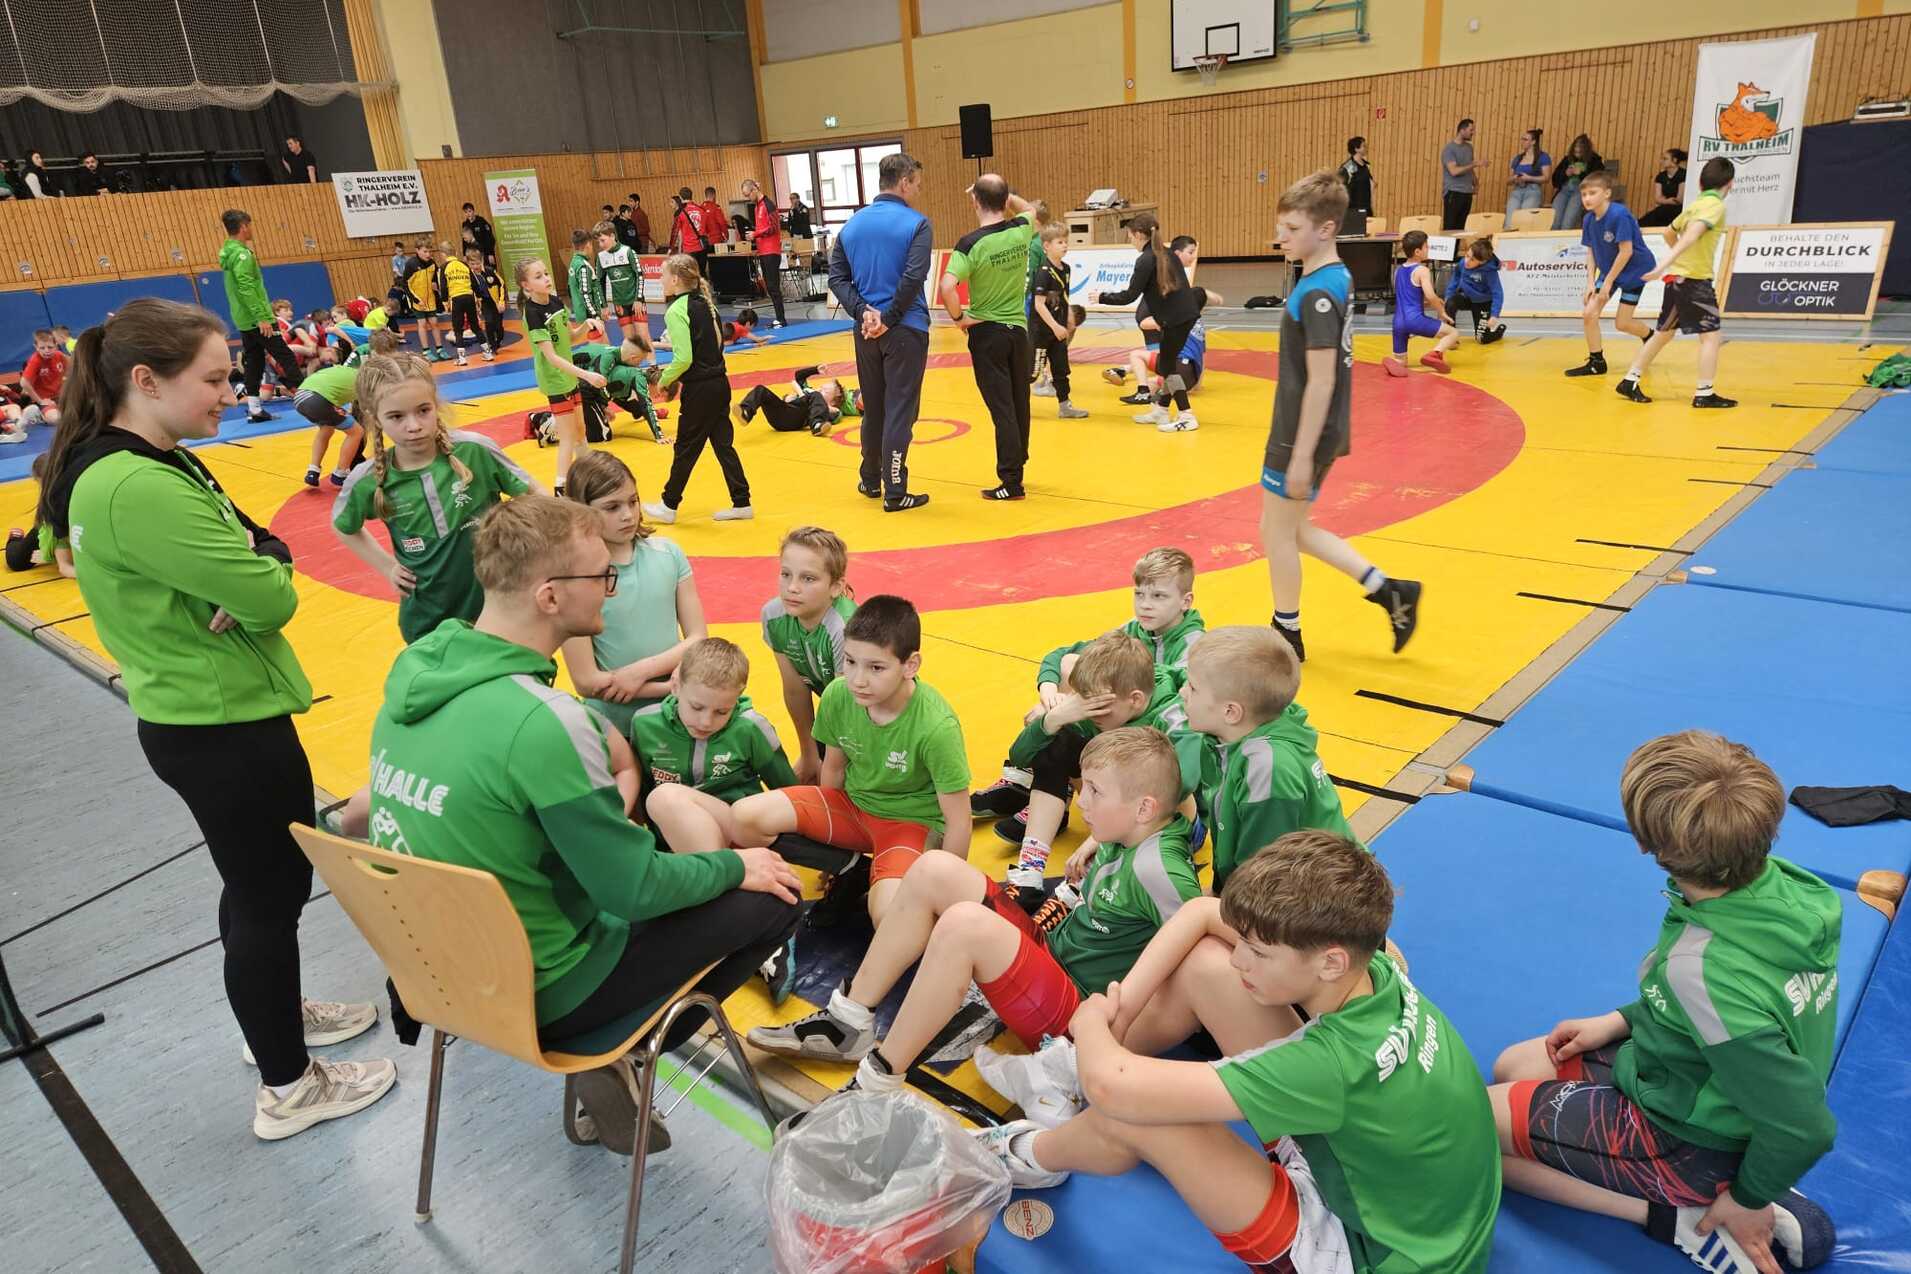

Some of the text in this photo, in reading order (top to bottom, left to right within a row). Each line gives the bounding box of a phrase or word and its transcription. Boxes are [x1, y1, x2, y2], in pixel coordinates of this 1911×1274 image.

[1703, 133, 1789, 152] RV THALHEIM
[356, 175, 416, 184] RINGERVEREIN
[1735, 173, 1780, 184] uchsteam
[344, 191, 421, 208] HK-HOLZ
[1769, 233, 1850, 242] BEHALTE DEN
[1746, 245, 1872, 257] DURCHBLICK
[1096, 270, 1130, 286] Mayer
[1760, 278, 1840, 292] GLÖCKNER
[1794, 296, 1836, 307] OPTIK
[1417, 1013, 1440, 1074] Ringen
[1021, 1200, 1035, 1238] BENZ
